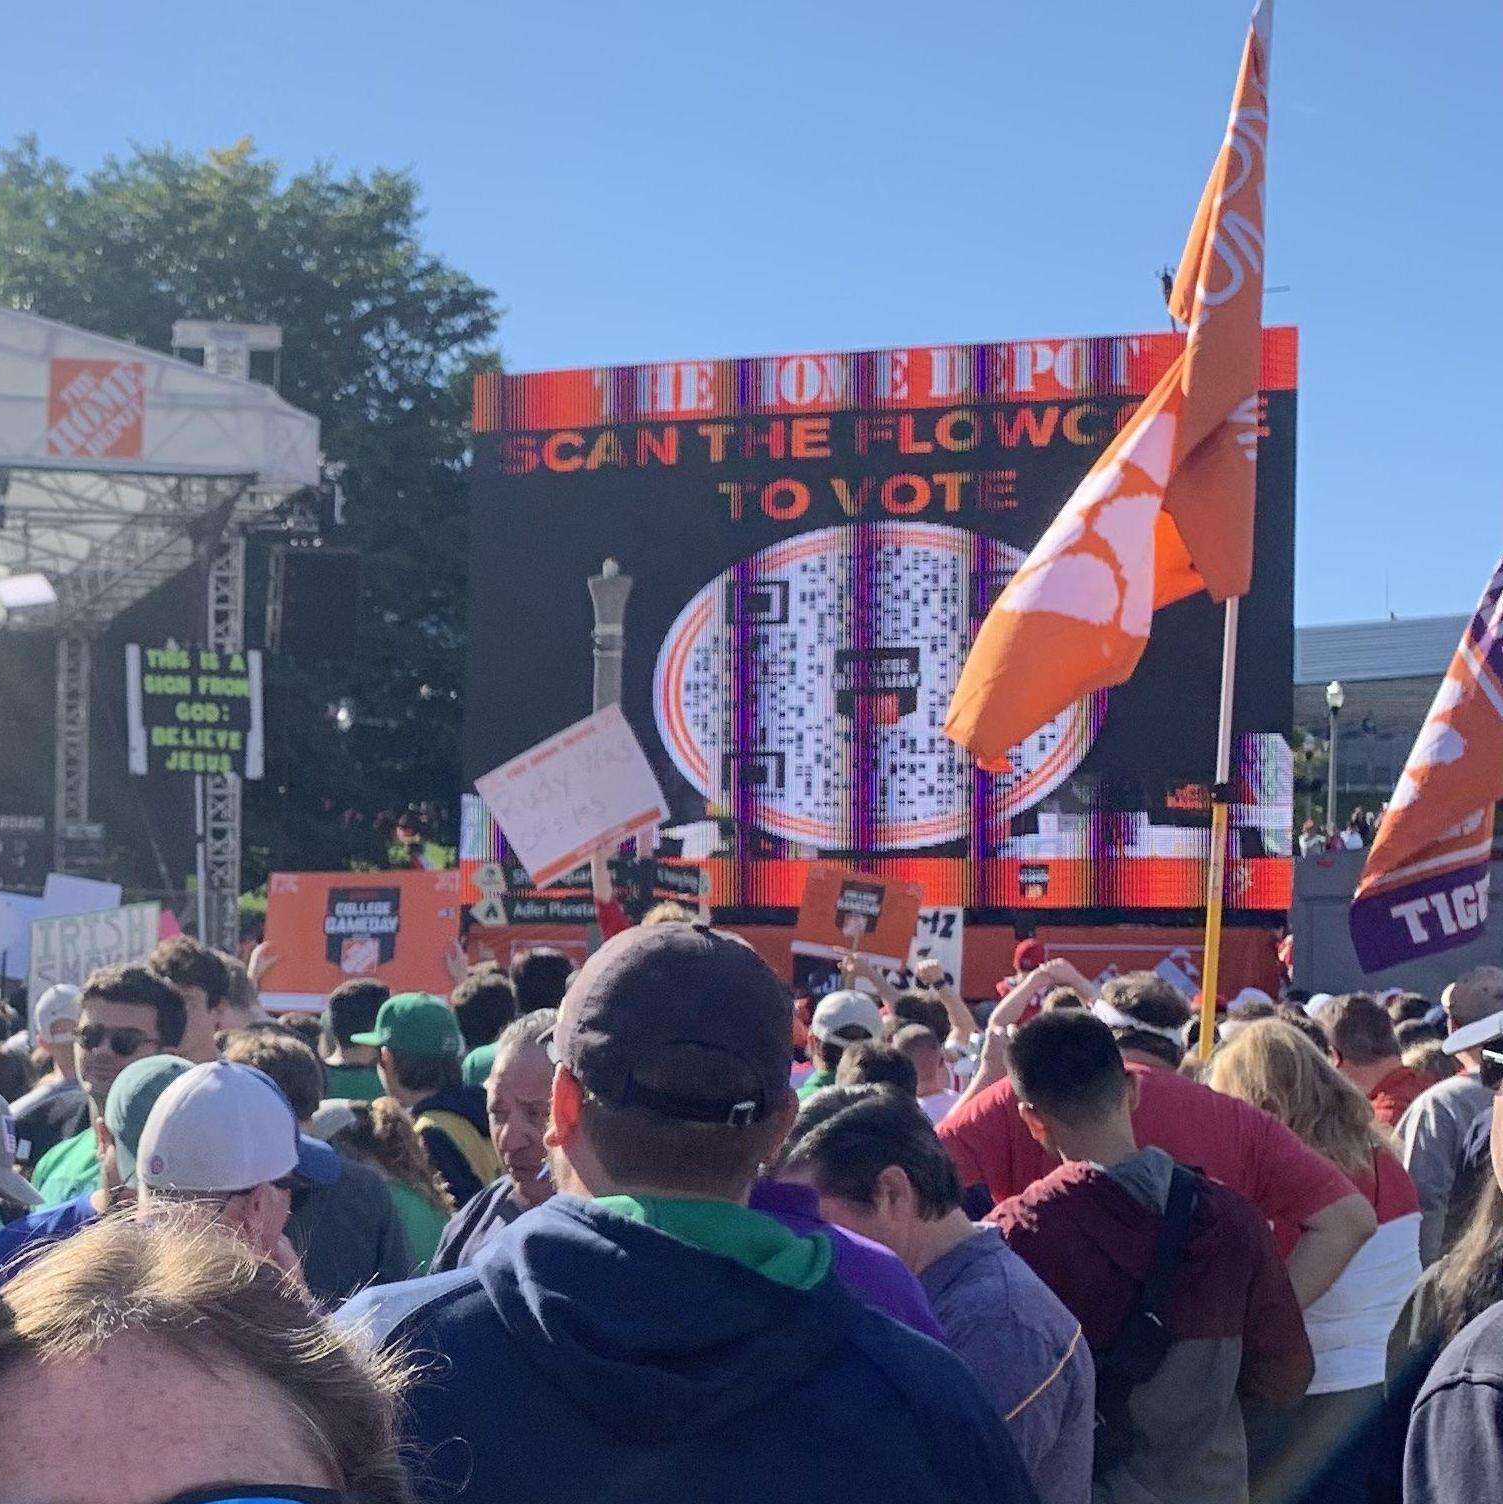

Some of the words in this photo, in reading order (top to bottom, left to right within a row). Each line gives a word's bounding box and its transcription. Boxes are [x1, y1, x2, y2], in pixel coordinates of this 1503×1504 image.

[503, 424, 679, 474] SCAN
[697, 416, 832, 463] THE
[718, 476, 811, 521] TO
[830, 468, 1018, 517] VOTE
[325, 915, 398, 934] GAMEDAY
[335, 901, 392, 917] COLLEGE
[513, 902, 547, 918] Adler
[549, 902, 597, 919] Planeta
[37, 907, 146, 958] IRISH
